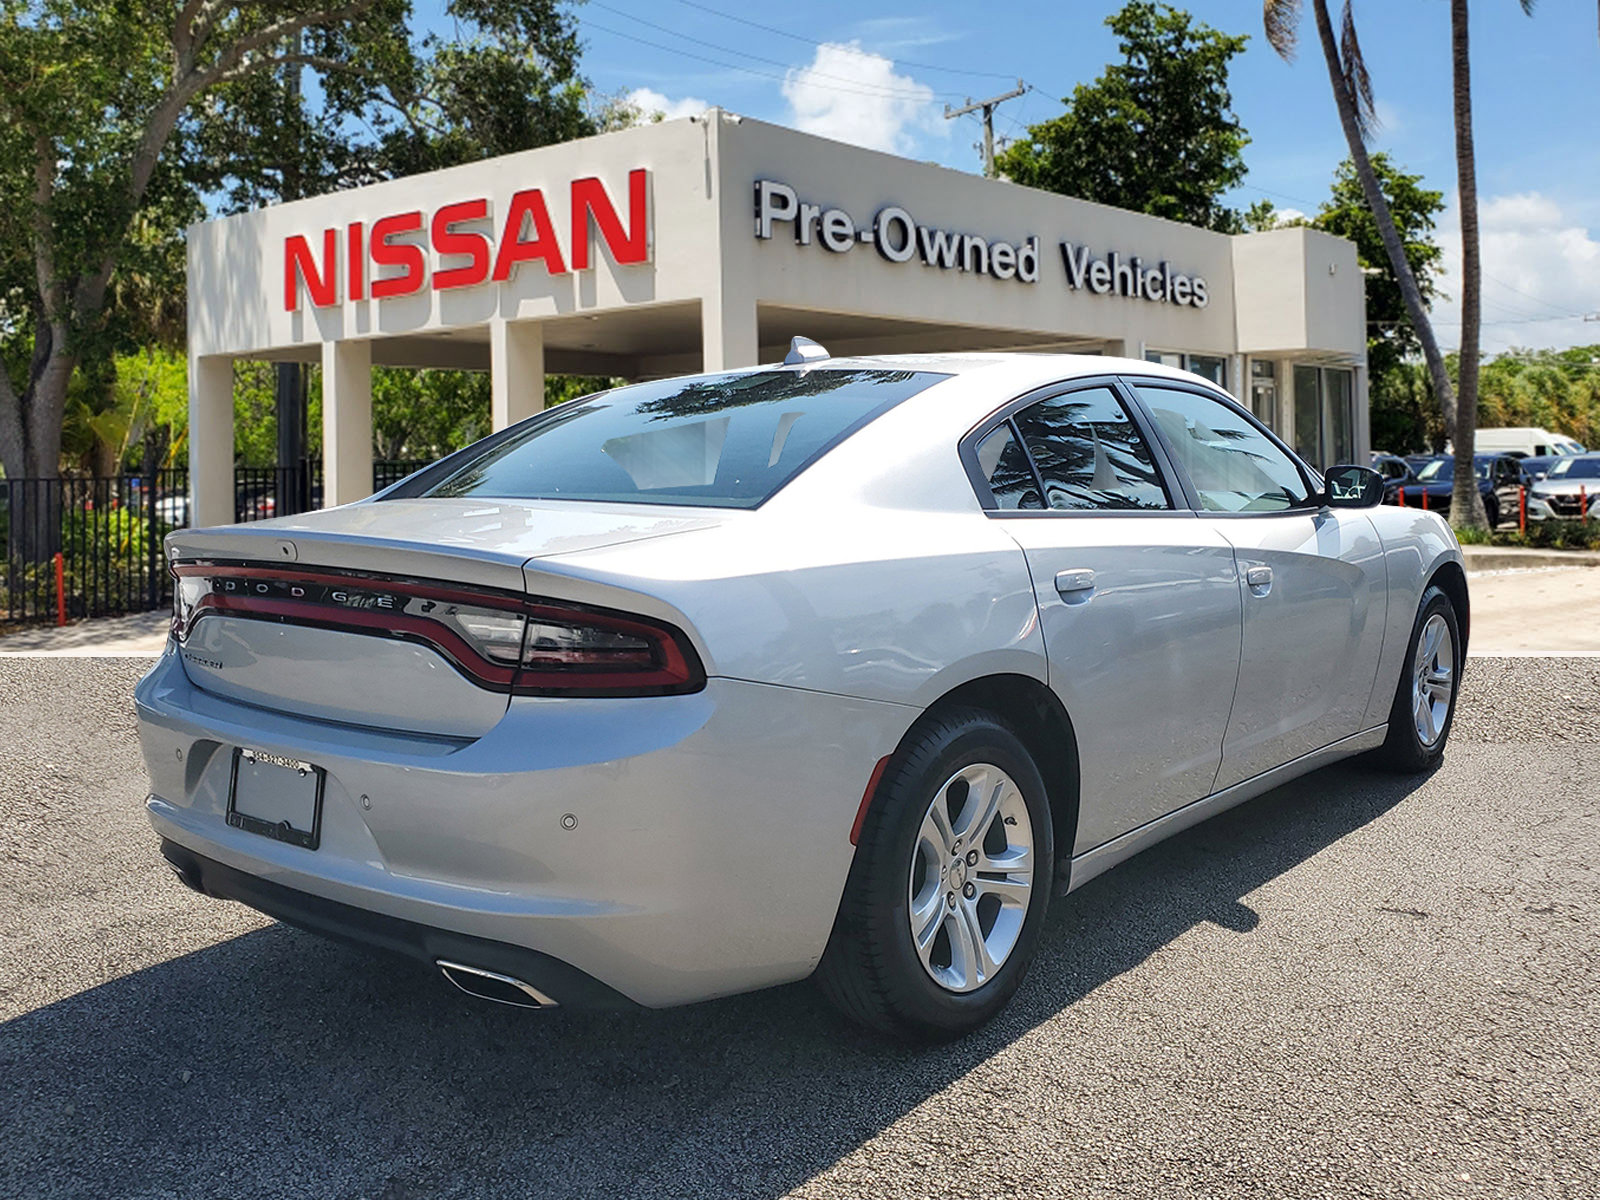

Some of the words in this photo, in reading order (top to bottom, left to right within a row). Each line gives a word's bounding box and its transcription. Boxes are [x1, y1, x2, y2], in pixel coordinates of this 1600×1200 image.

[284, 168, 648, 312] NISSAN
[754, 180, 1041, 283] Pre-Owned
[1061, 241, 1208, 308] Vehicles
[225, 581, 394, 609] DODGE
